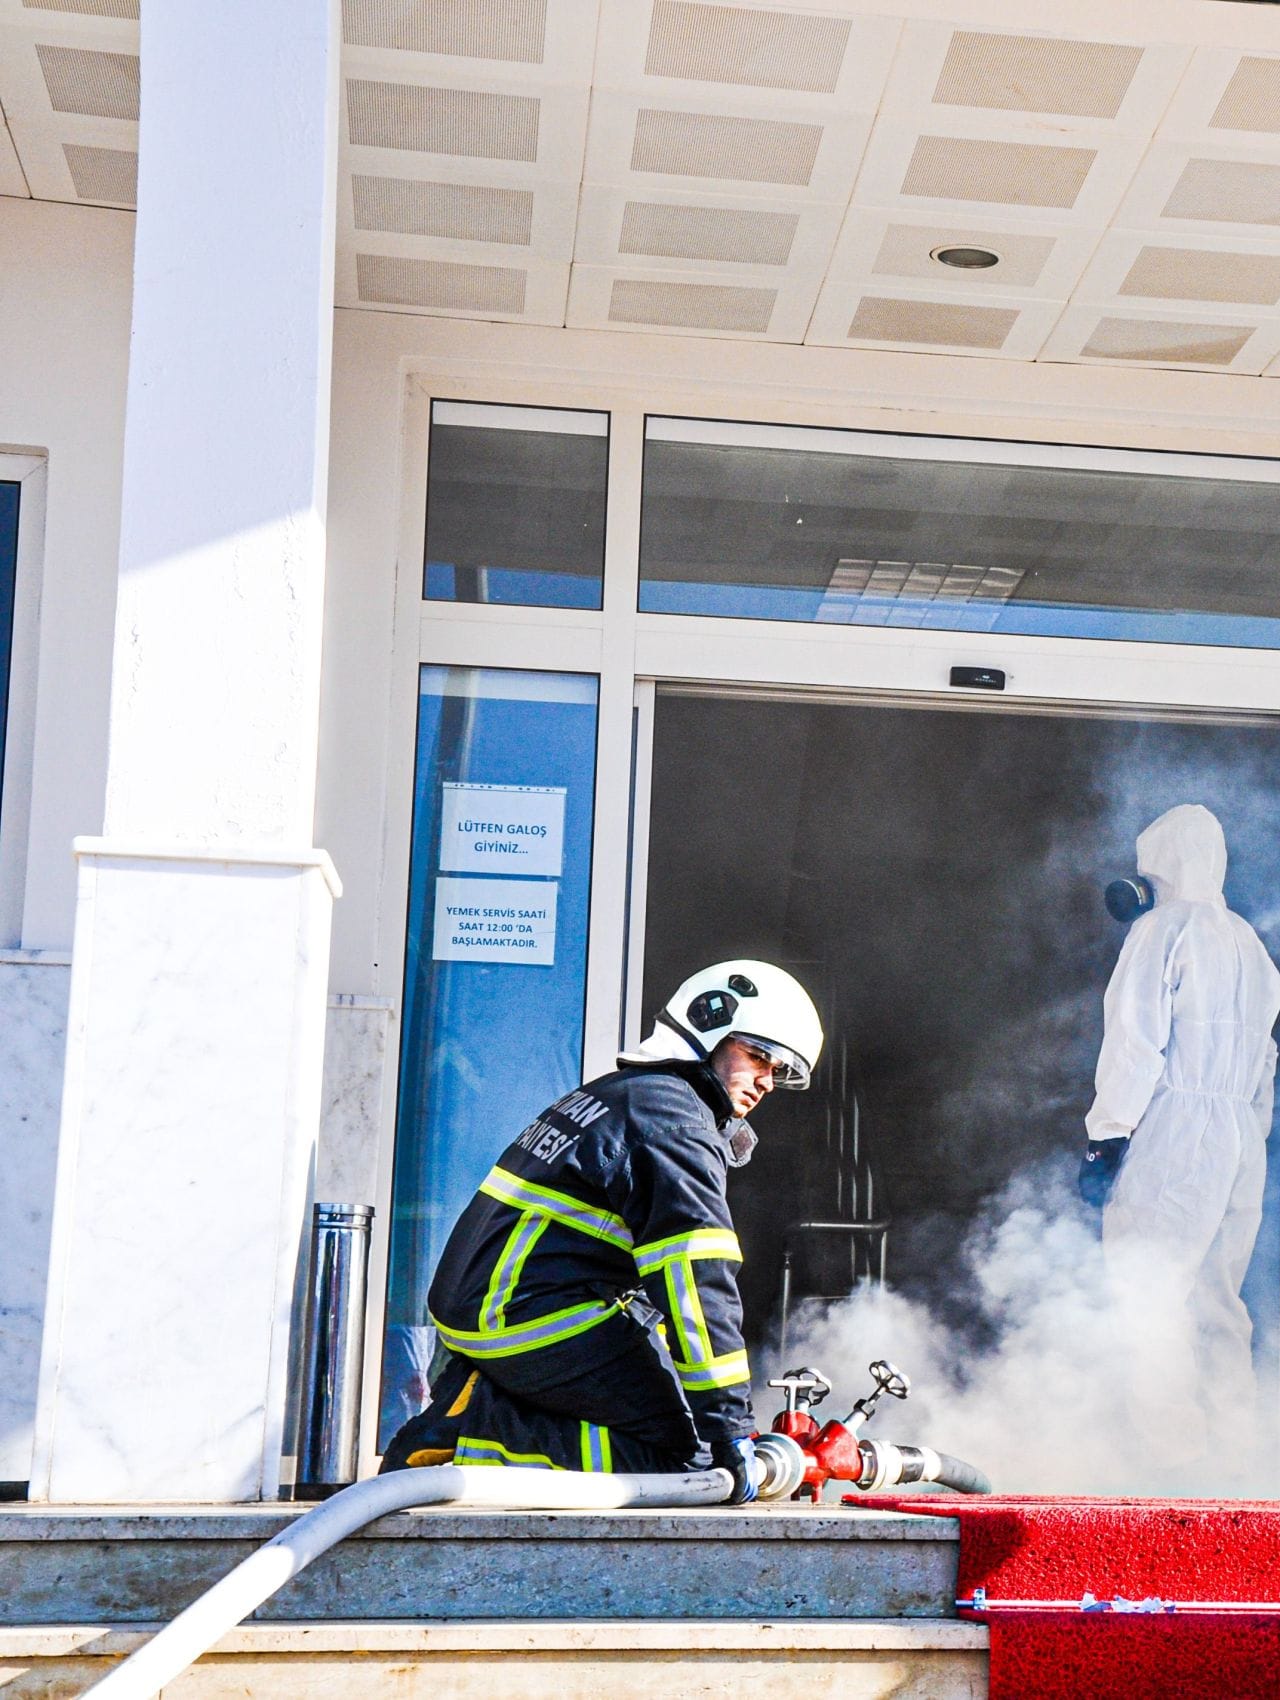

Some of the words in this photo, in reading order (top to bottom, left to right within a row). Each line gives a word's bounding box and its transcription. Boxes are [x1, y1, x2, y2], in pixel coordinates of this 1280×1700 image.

[458, 819, 503, 834] LÜTFEN
[506, 823, 547, 838] GALOŞ
[446, 906, 480, 917] YEMEK
[482, 907, 515, 919] SERVİS
[518, 909, 546, 919] SAATİ
[459, 921, 484, 931] SAAT
[487, 923, 513, 933] 12:00
[452, 936, 538, 948] BAŞLAMAKTADIR.
